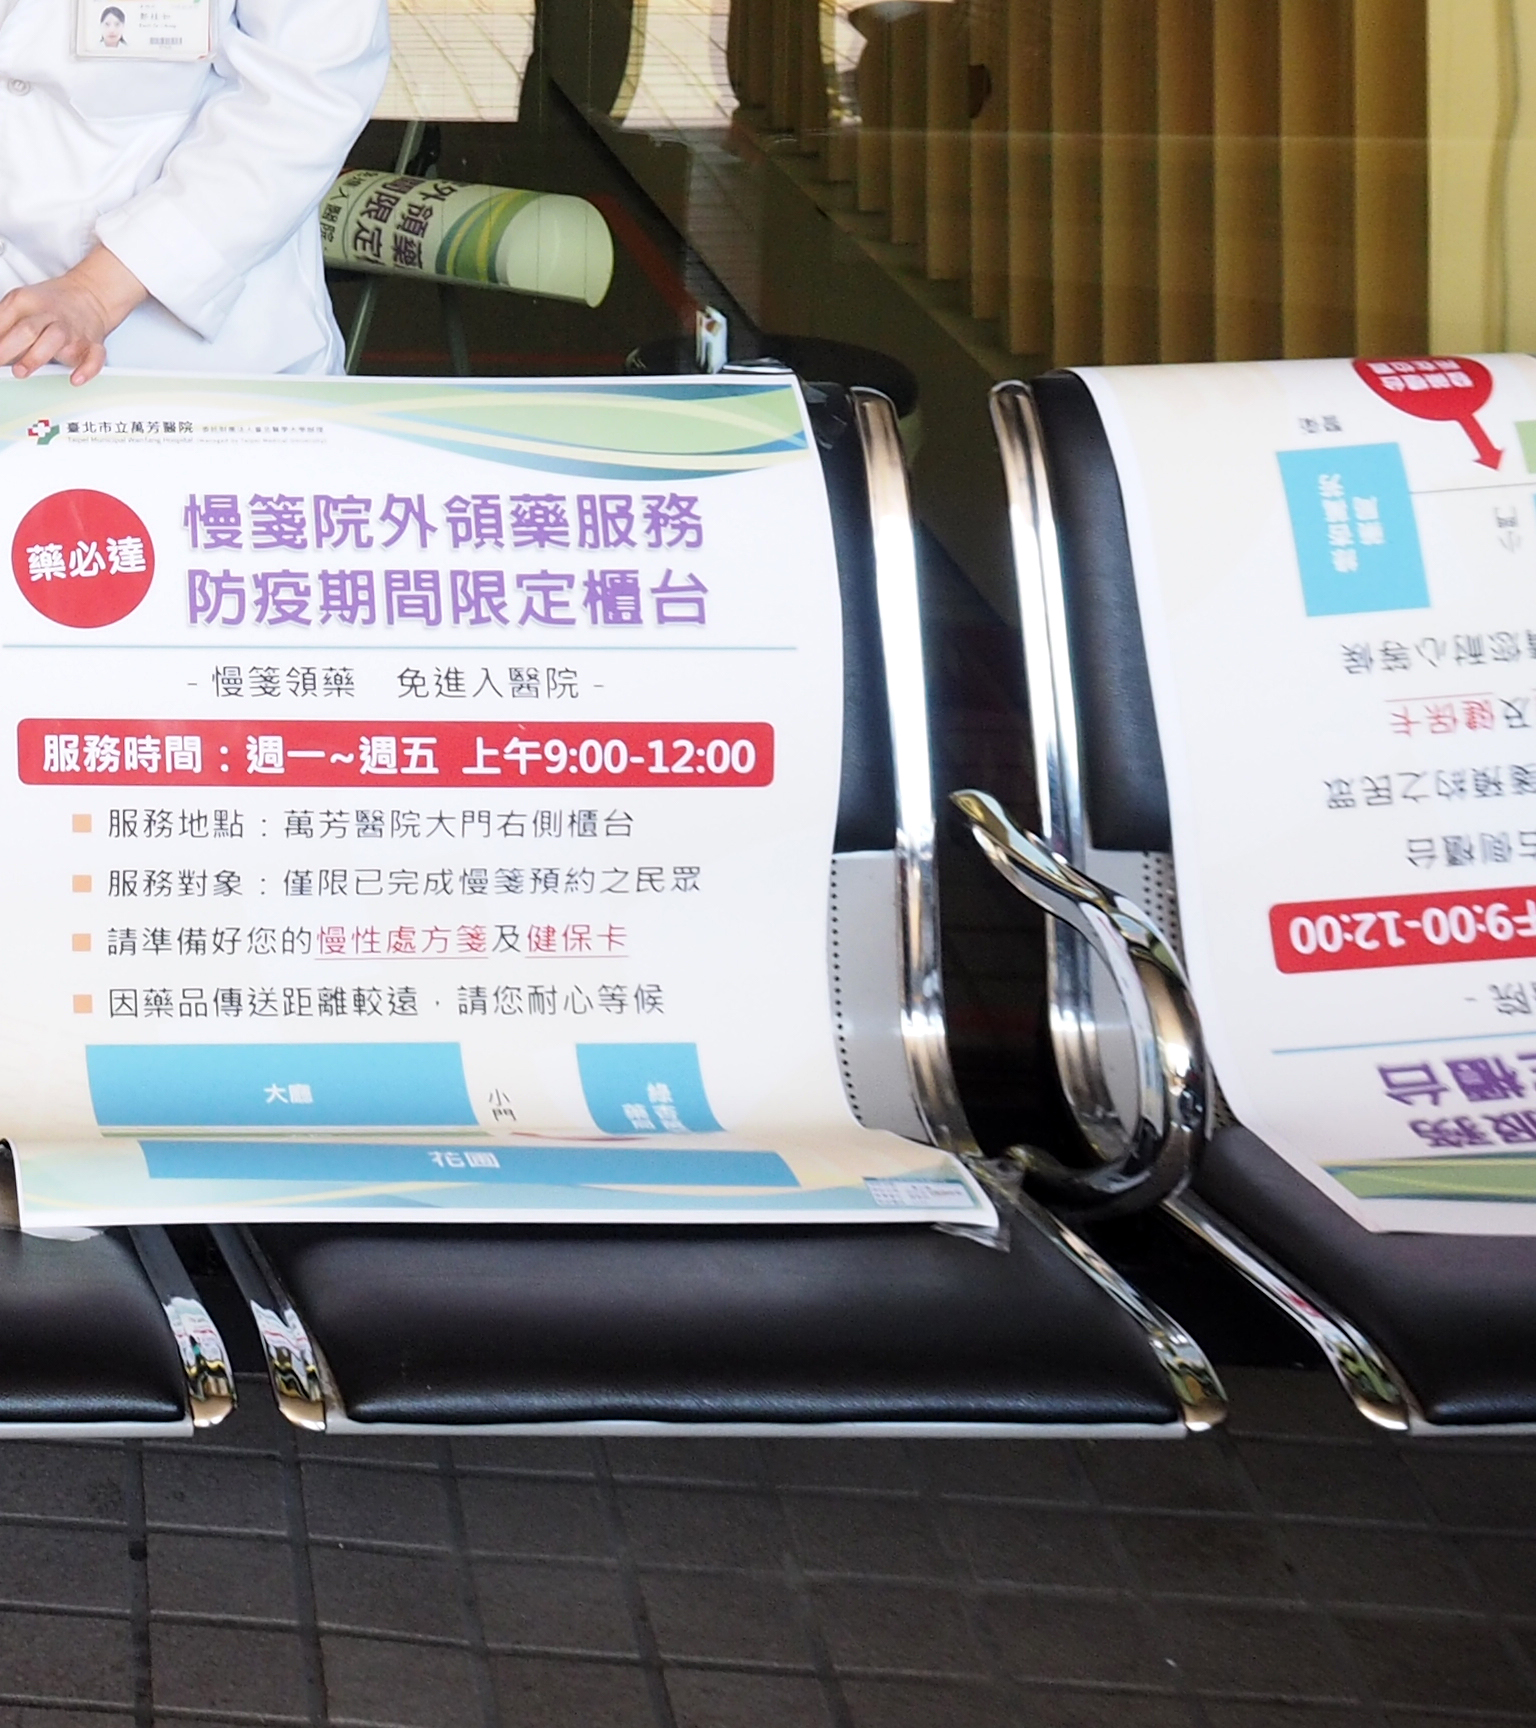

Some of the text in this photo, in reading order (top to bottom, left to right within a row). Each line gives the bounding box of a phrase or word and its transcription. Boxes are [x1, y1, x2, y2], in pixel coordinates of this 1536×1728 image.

[354, 176, 419, 265] 間限定
[67, 420, 194, 434] 臺北市立萬芳醫院
[185, 492, 705, 553] 慢箋院外領藥服務
[26, 537, 147, 581] 藥必達
[185, 568, 712, 628] 防疫期間限定櫃台
[211, 665, 580, 701] 慢箋領藥 免進入醫院
[42, 733, 756, 777] 服務時間：週一~週五 上午9:00-12:00
[106, 808, 635, 841] 服務地點：萬芳醫院大門右側櫃台
[106, 865, 703, 899] 服務對象：僅限已完成慢箋預約之民眾
[106, 923, 629, 957] 請準備好您的慢性處方箋及健保卡
[1488, 979, 1536, 1017] 院
[264, 1082, 312, 1106] 大廳
[487, 1087, 518, 1124] 小門
